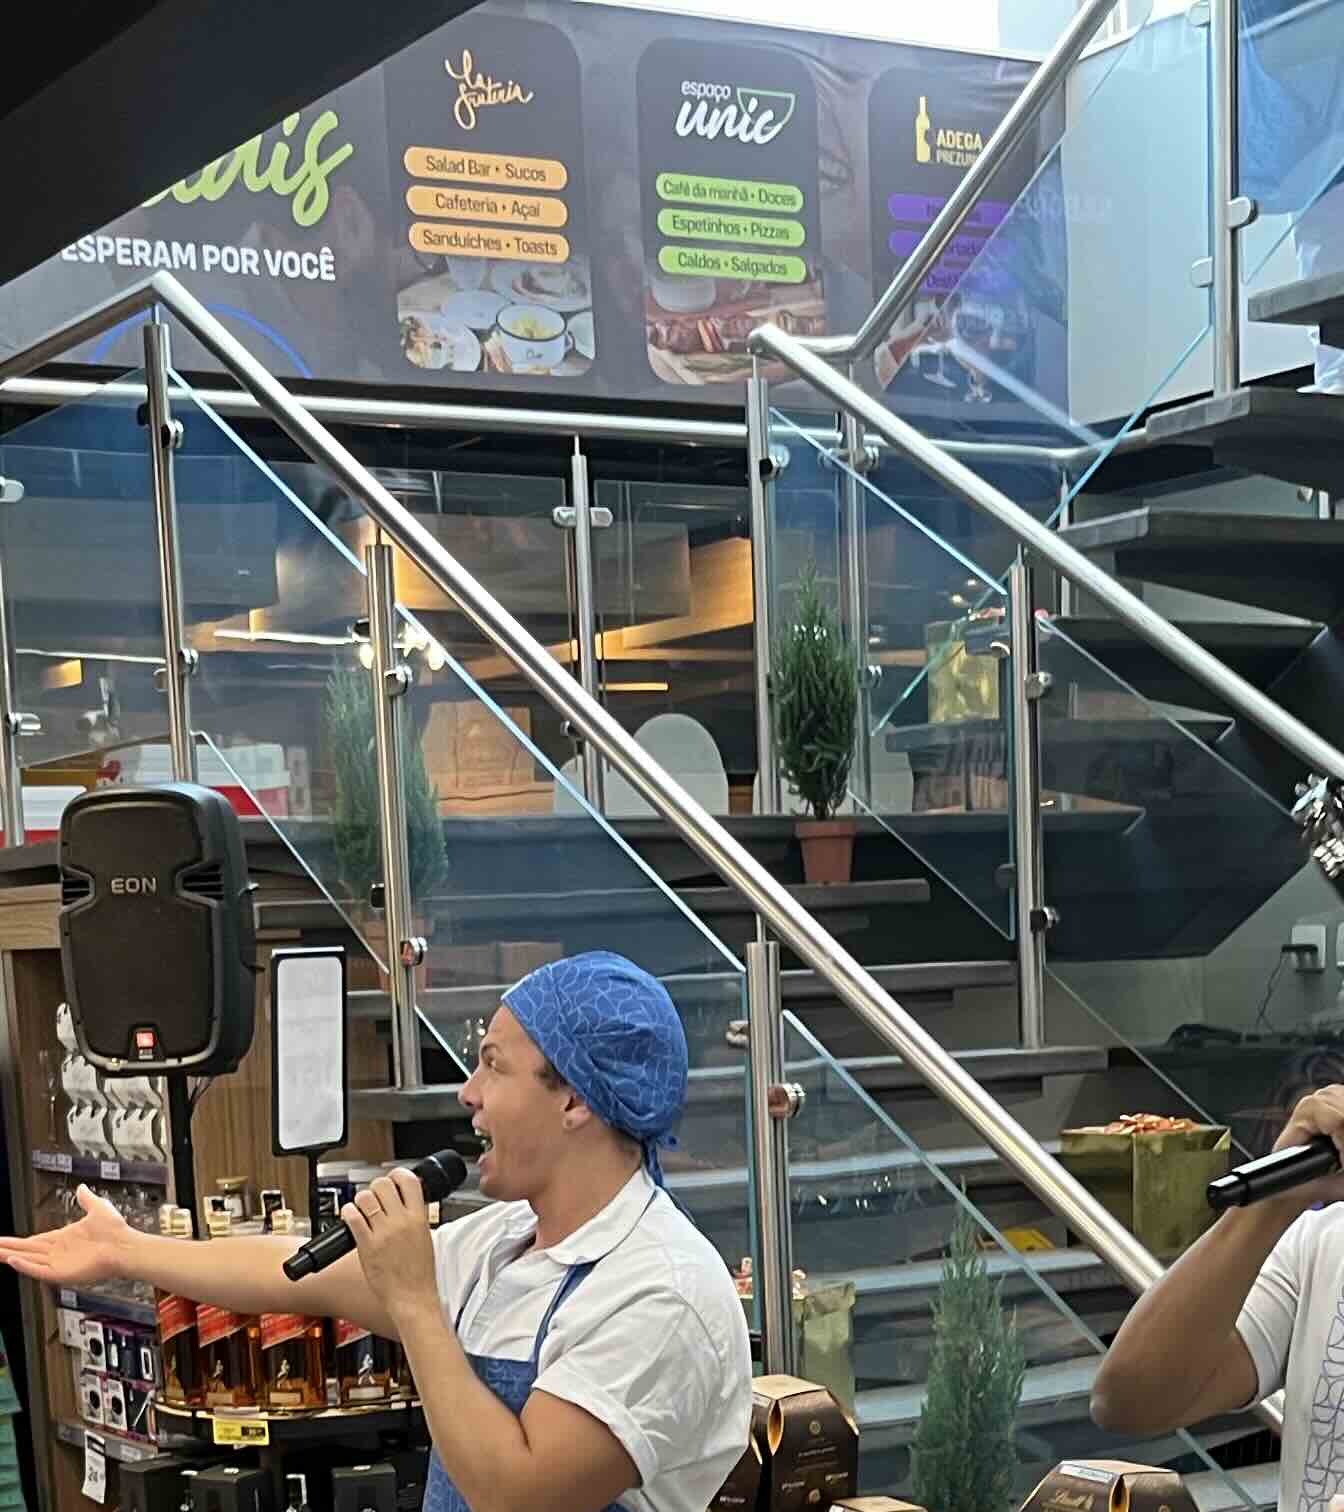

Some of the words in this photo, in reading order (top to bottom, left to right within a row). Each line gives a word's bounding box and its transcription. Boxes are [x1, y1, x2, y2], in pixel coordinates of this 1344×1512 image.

[680, 80, 732, 103] espaço
[936, 129, 984, 151] ADEGA
[425, 154, 465, 175] Salad
[468, 159, 492, 177] Bar
[504, 163, 547, 183] Sucos
[434, 192, 499, 214] Cafeteria
[663, 179, 691, 196] Café
[692, 181, 707, 199] da
[758, 189, 797, 207] Doces
[671, 214, 742, 237] Espetinhos
[750, 222, 791, 241] Pizzas
[61, 234, 198, 272] ESPERAM
[202, 243, 261, 277] POR
[262, 245, 337, 282] VOCÊ
[513, 237, 559, 256] Toasts
[677, 251, 721, 271] Caldos
[730, 256, 788, 277] Salgados
[111, 877, 157, 895] EON
